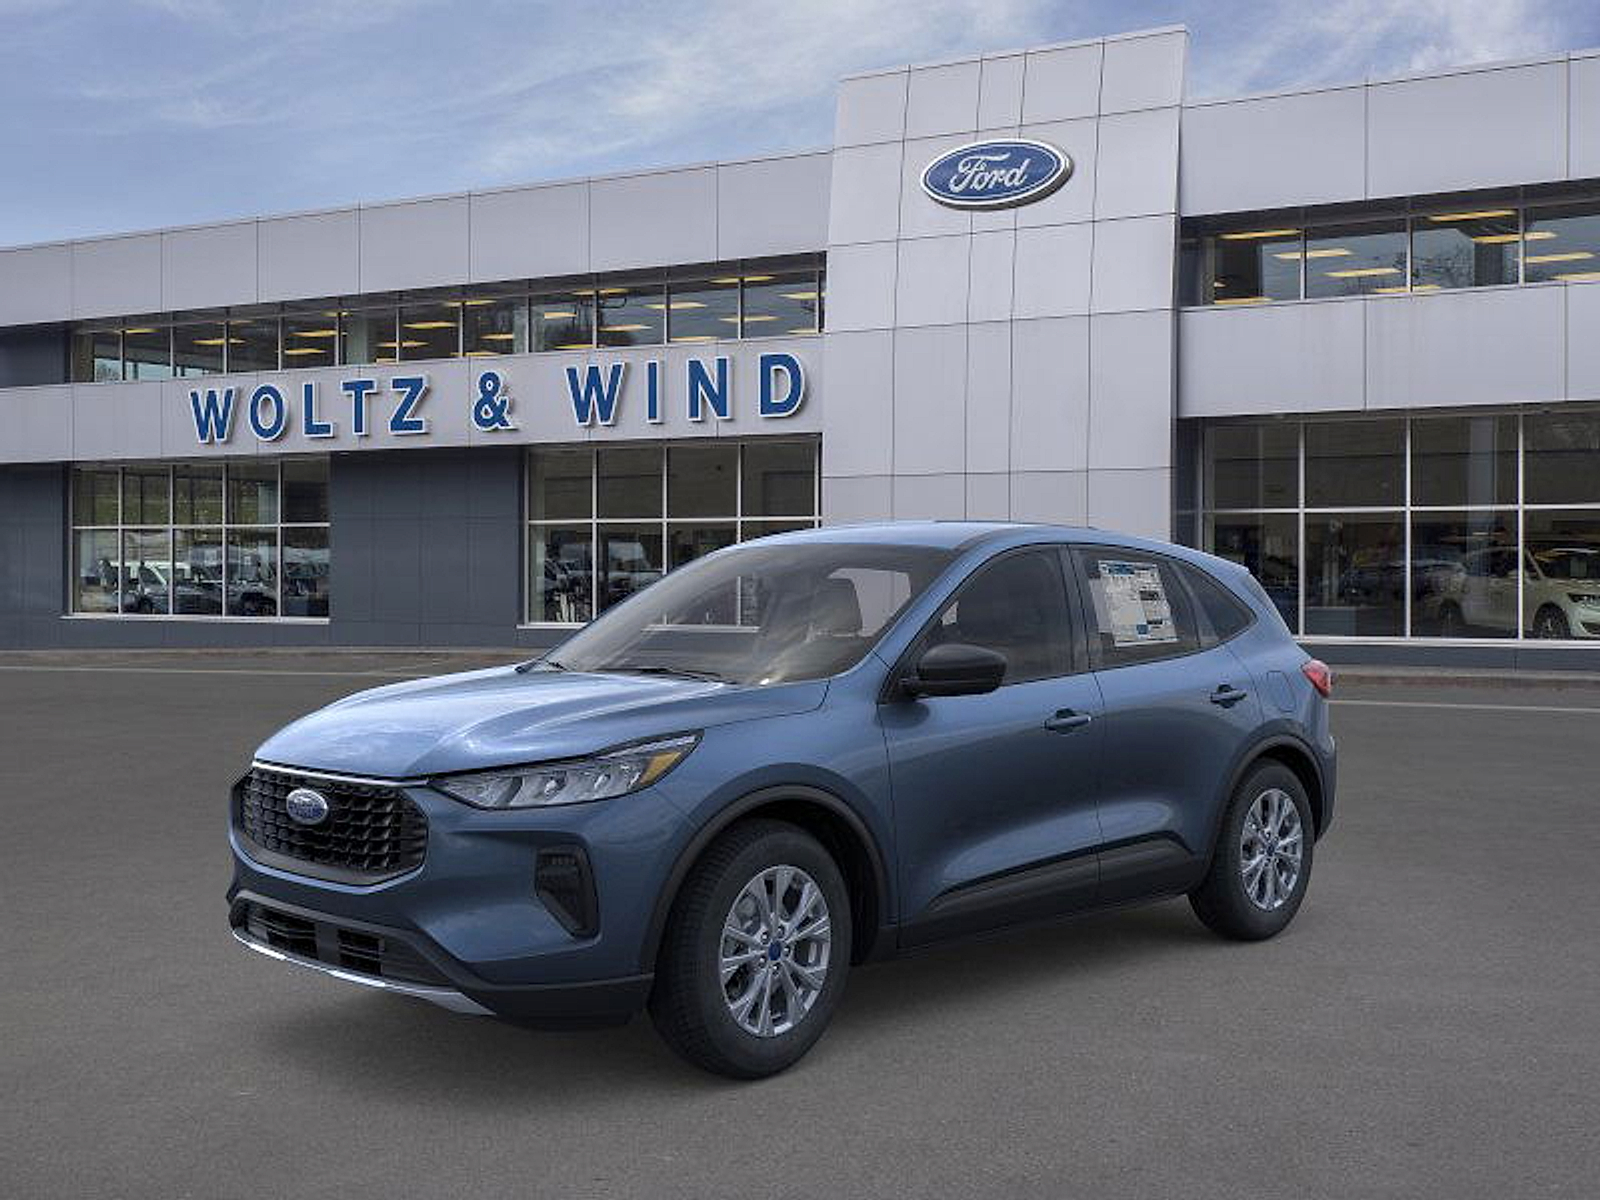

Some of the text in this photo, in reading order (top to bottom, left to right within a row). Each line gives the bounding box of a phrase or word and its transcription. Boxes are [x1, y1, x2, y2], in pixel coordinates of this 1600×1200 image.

[950, 152, 1031, 193] Ford
[190, 352, 806, 443] WOLTZ & WIND
